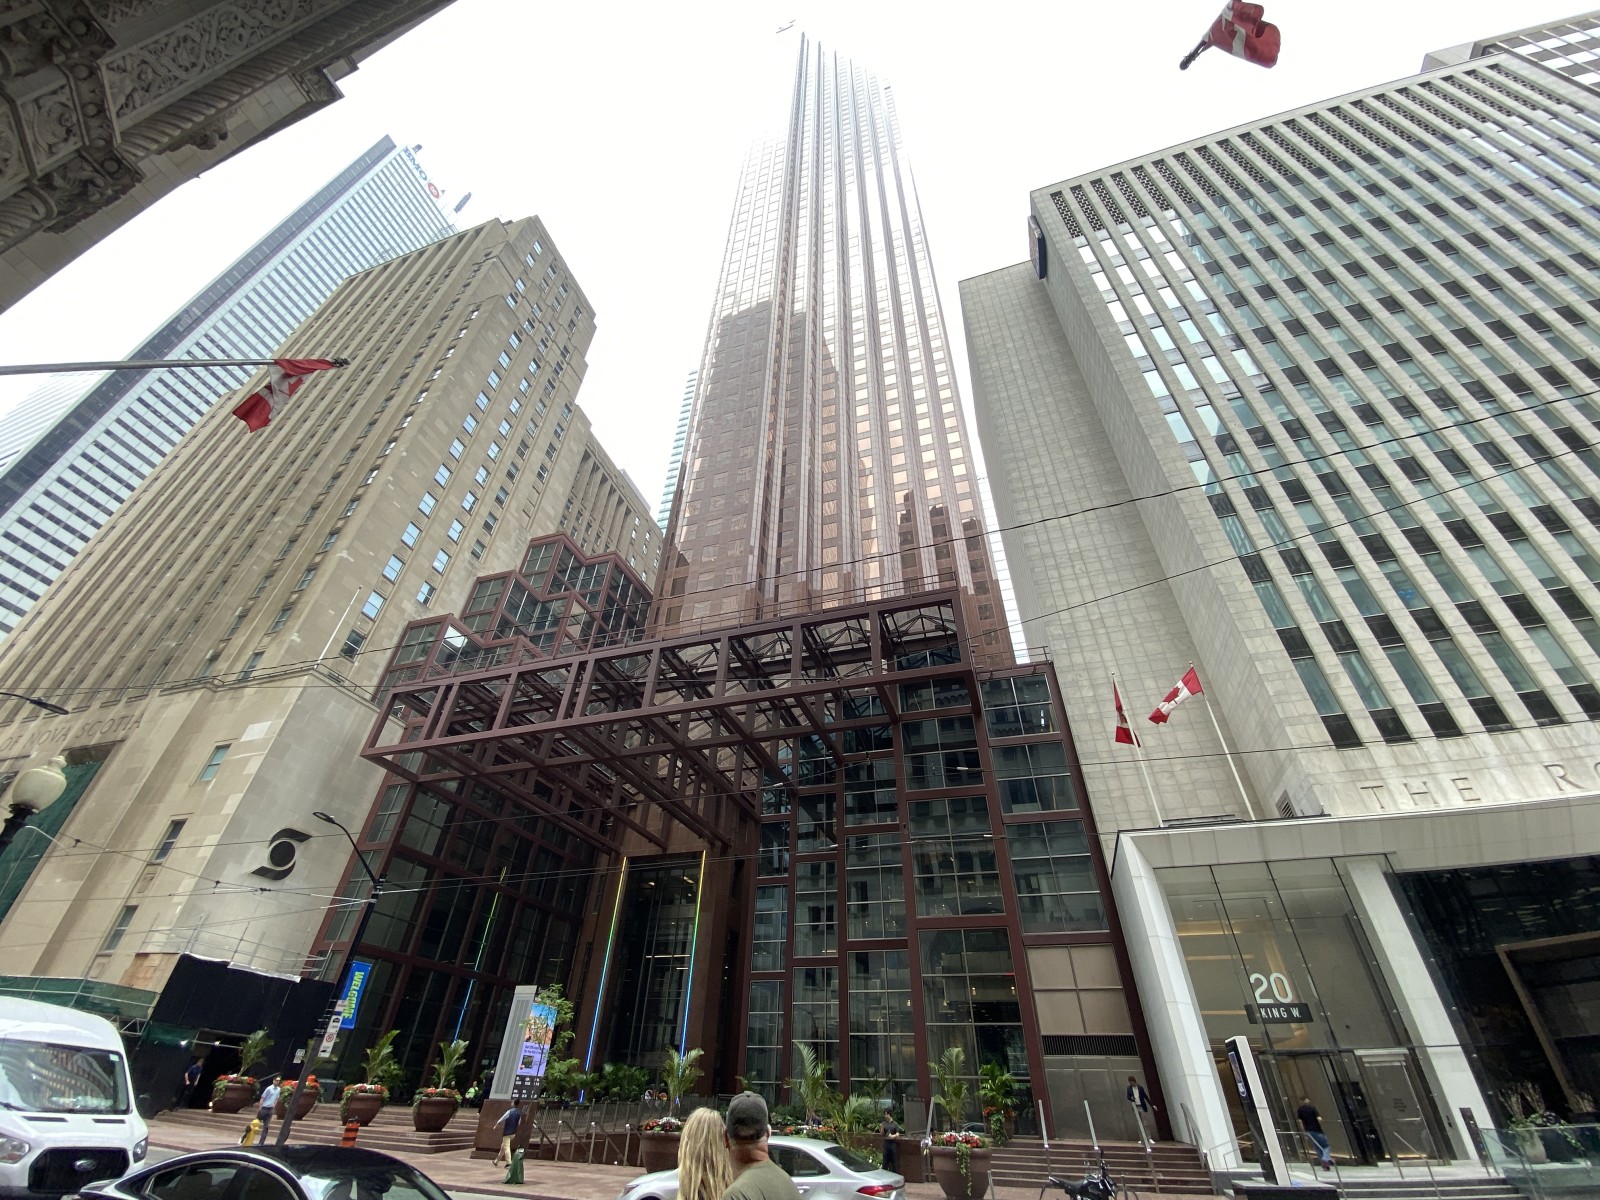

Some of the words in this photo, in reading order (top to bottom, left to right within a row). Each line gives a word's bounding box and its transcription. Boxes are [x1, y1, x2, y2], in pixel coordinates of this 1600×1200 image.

[403, 146, 428, 181] BMO
[0, 735, 23, 752] OF
[24, 725, 72, 748] NOVA
[76, 713, 145, 739] SCOTIA
[1360, 776, 1482, 809] THE
[1543, 762, 1600, 792] R
[342, 971, 365, 1019] WELCOME
[1249, 972, 1293, 1004] 20
[1259, 1006, 1288, 1019] KING
